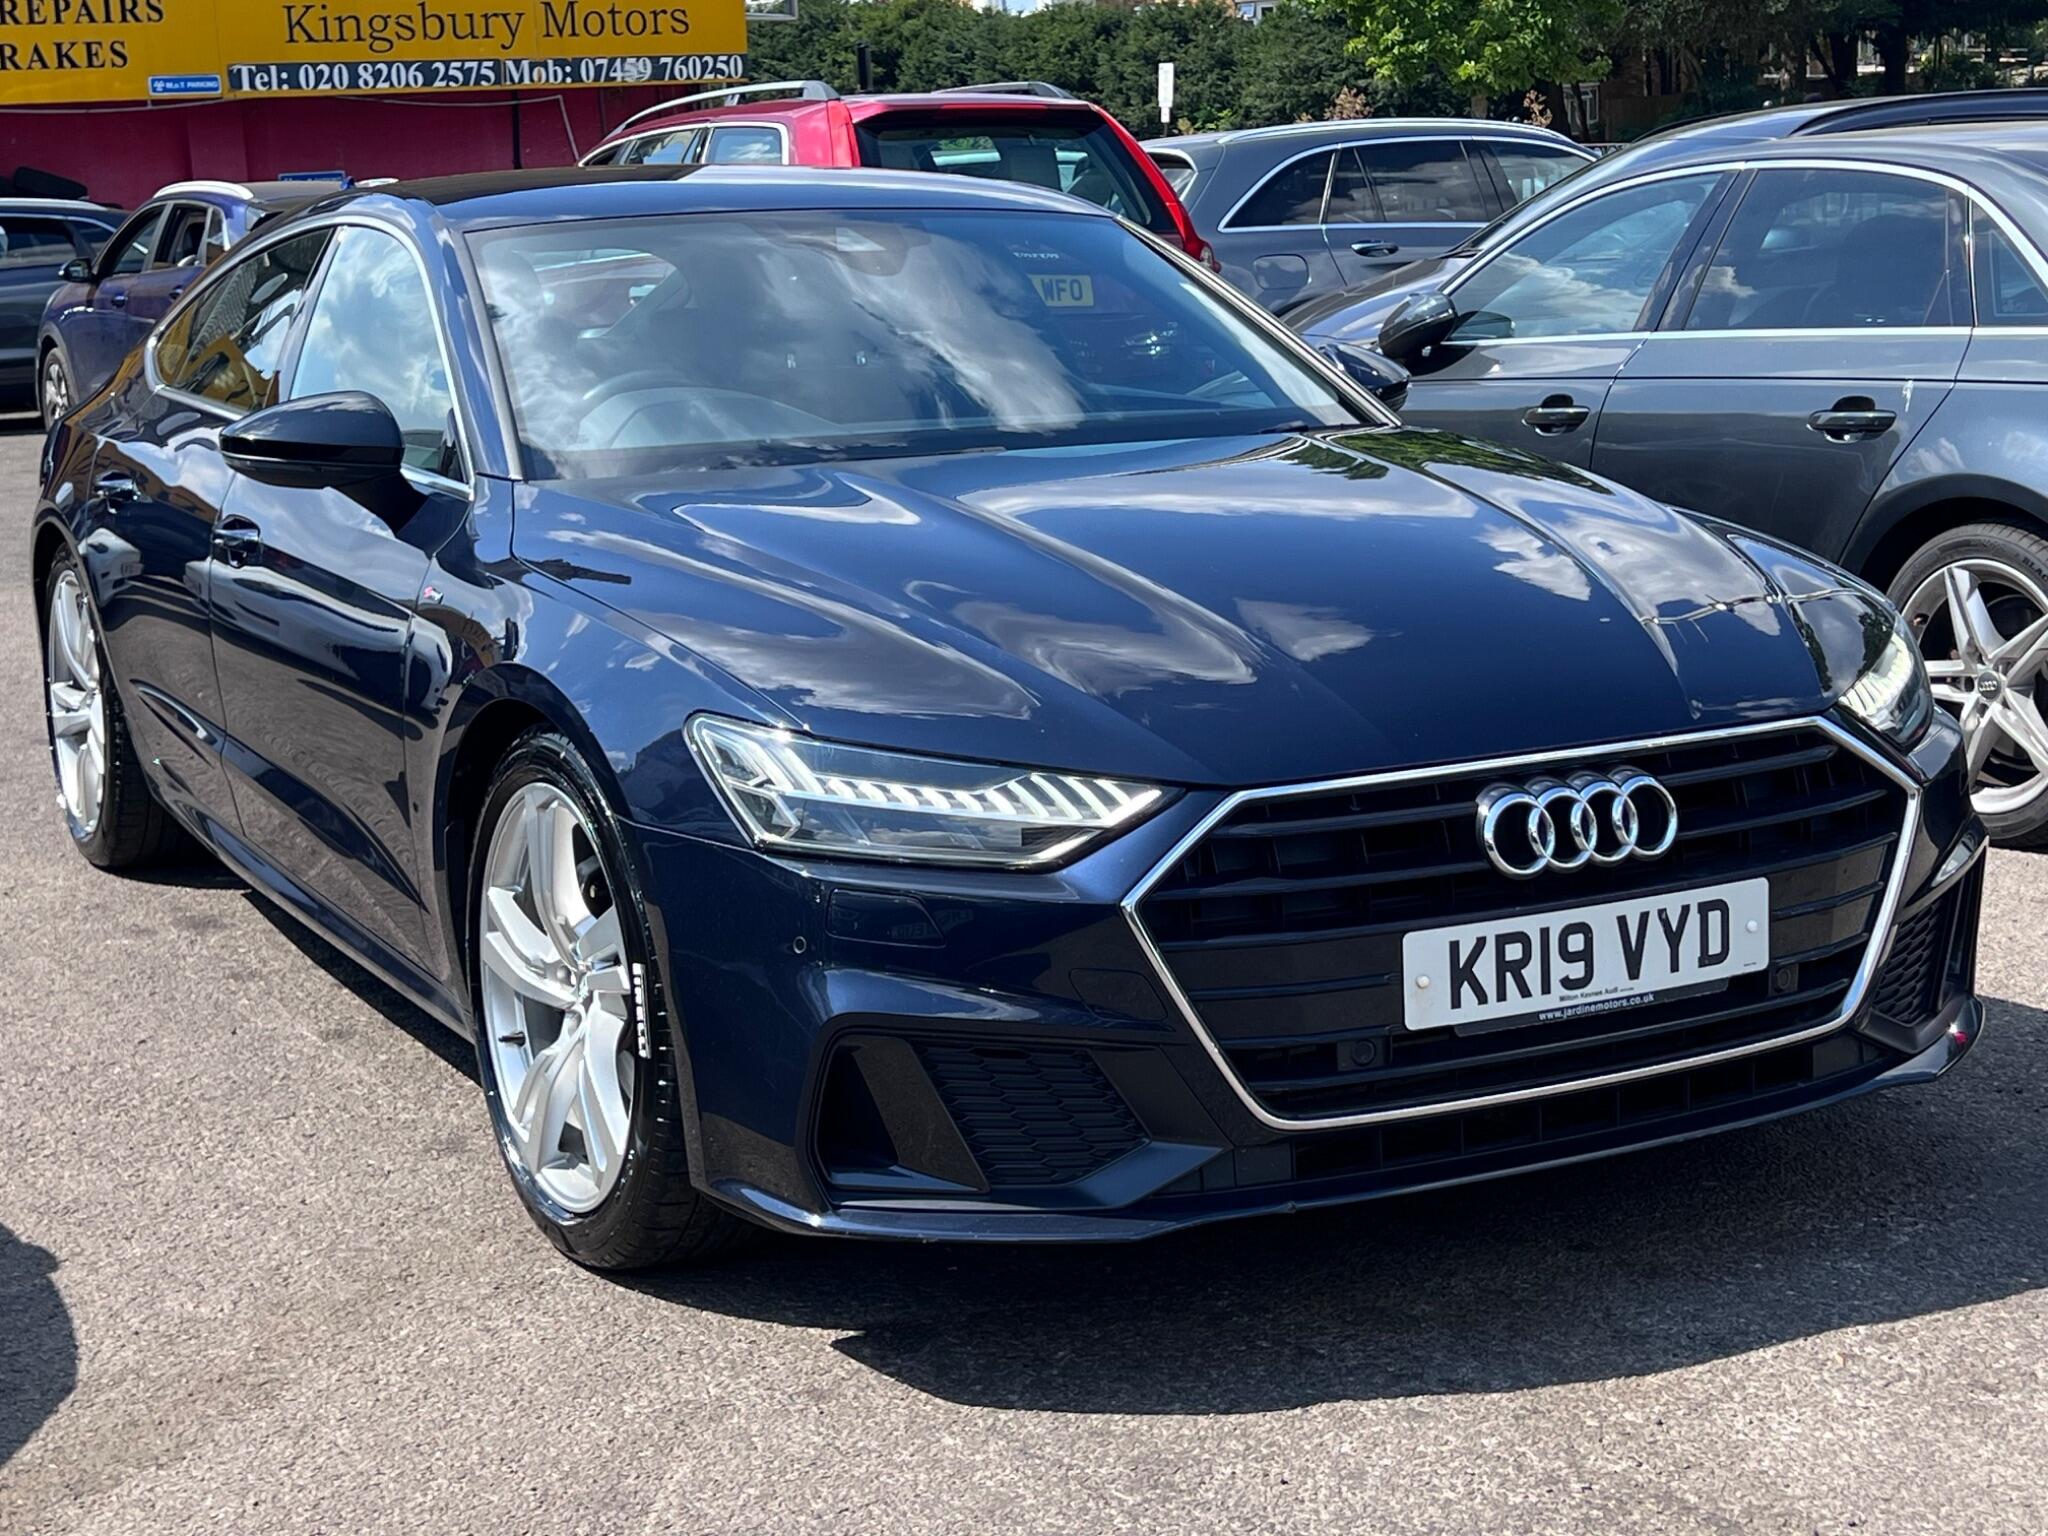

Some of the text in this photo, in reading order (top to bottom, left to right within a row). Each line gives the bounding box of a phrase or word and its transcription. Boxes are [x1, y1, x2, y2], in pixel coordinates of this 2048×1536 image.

[0, 0, 164, 25] REPAIRS
[282, 1, 689, 53] Kingsbury Motors
[229, 64, 289, 91] Tel:
[299, 63, 349, 90] 020
[357, 62, 424, 89] 8206
[431, 61, 496, 87] 2575
[505, 59, 571, 86] Mob:
[659, 55, 743, 81] 760250
[1449, 898, 1730, 1010] KR19 VYD
[1539, 993, 1655, 1020] www.jardinemotors.co.uk
